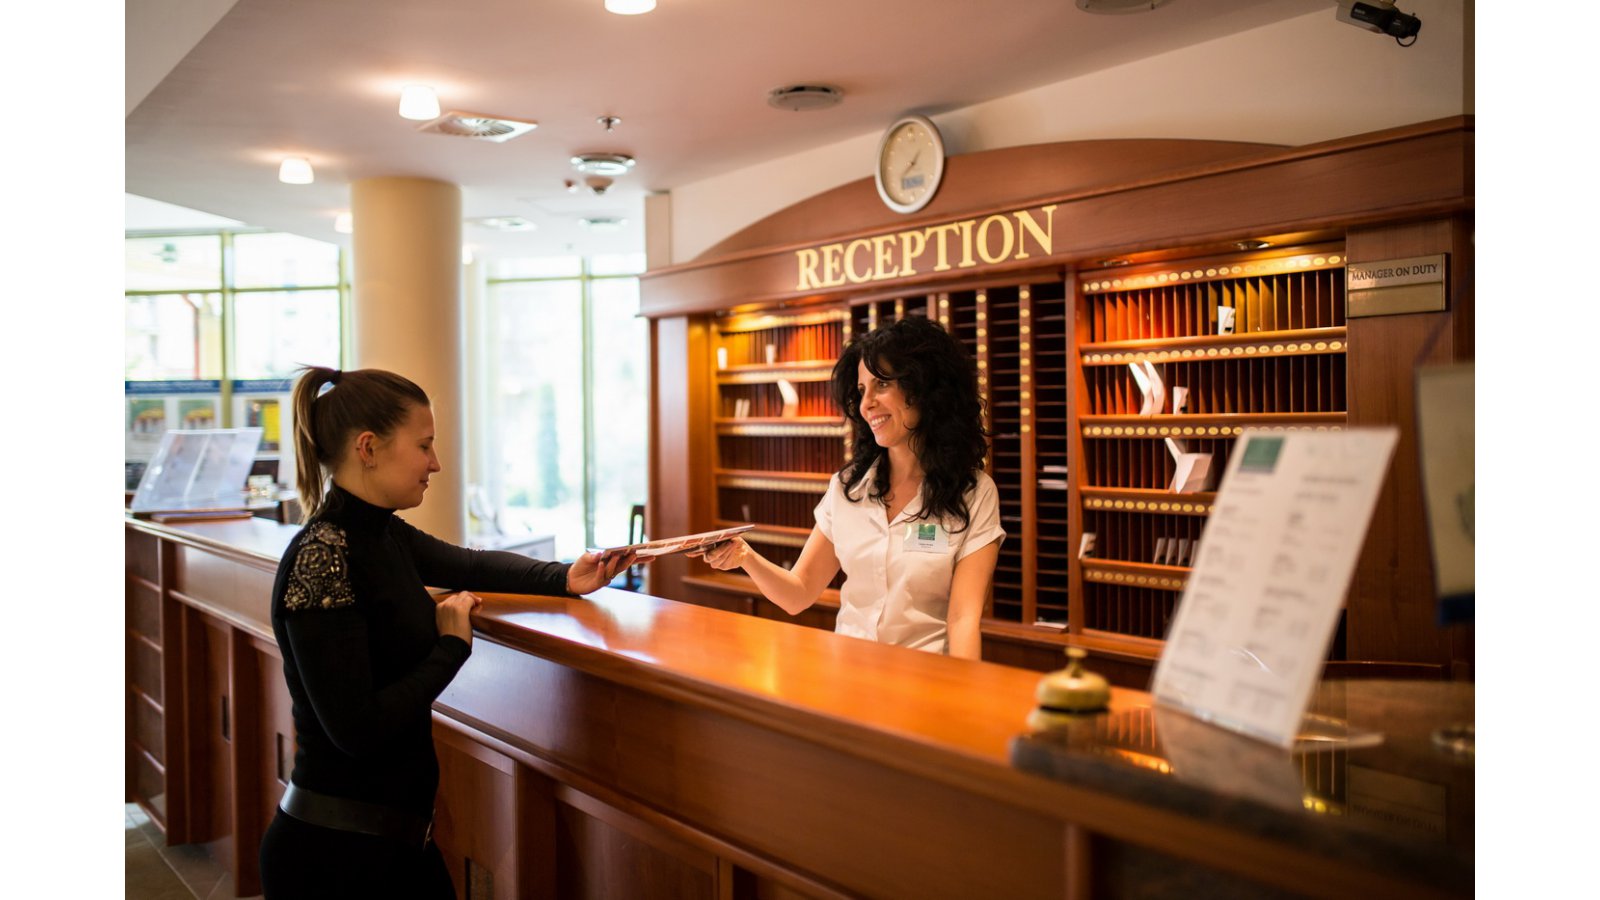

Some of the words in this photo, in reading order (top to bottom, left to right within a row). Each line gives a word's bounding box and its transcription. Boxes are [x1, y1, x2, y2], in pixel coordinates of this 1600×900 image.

[795, 205, 1057, 291] RECEPTION
[1352, 269, 1394, 281] MANAGER
[1395, 266, 1411, 277] ON
[1412, 264, 1437, 275] DUTY
